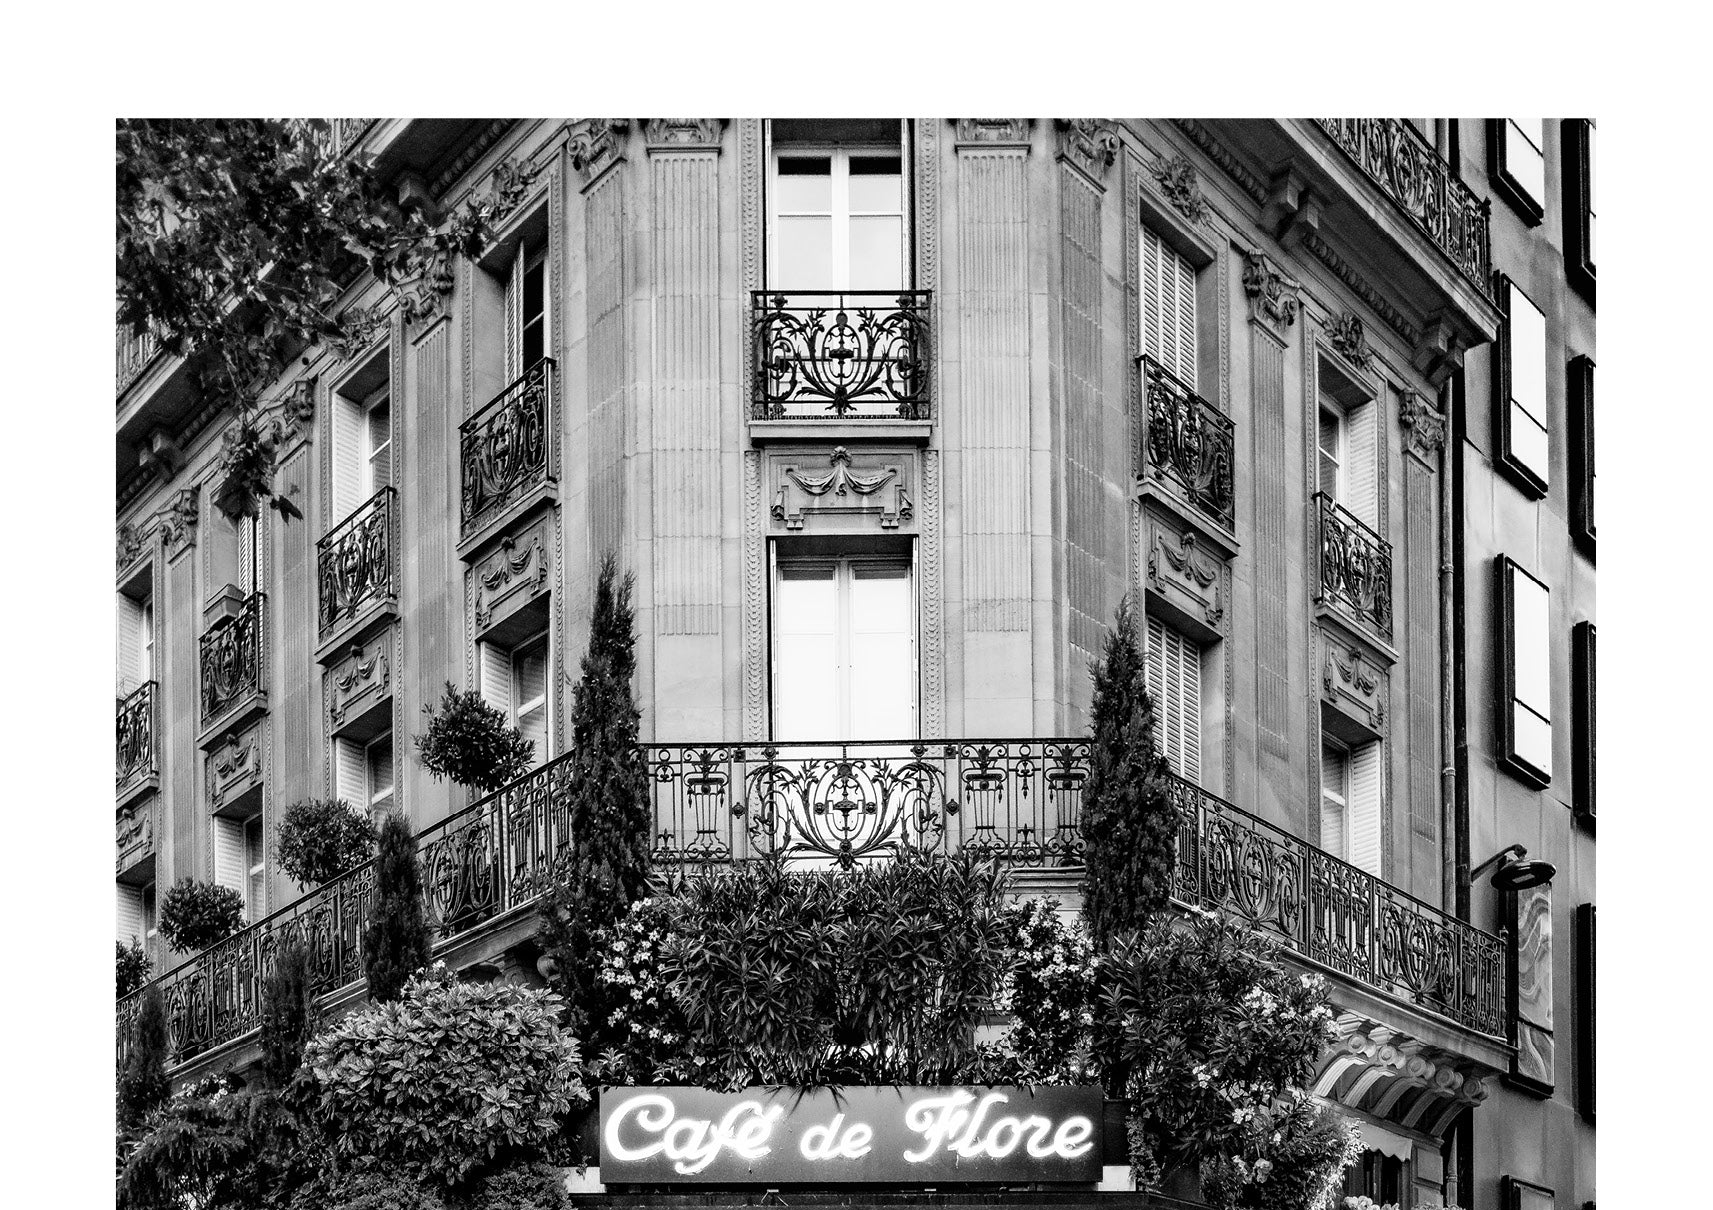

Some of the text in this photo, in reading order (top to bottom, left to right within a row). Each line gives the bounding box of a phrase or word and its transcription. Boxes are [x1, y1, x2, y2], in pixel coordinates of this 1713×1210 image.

[604, 1090, 1094, 1175] Café de Flore
